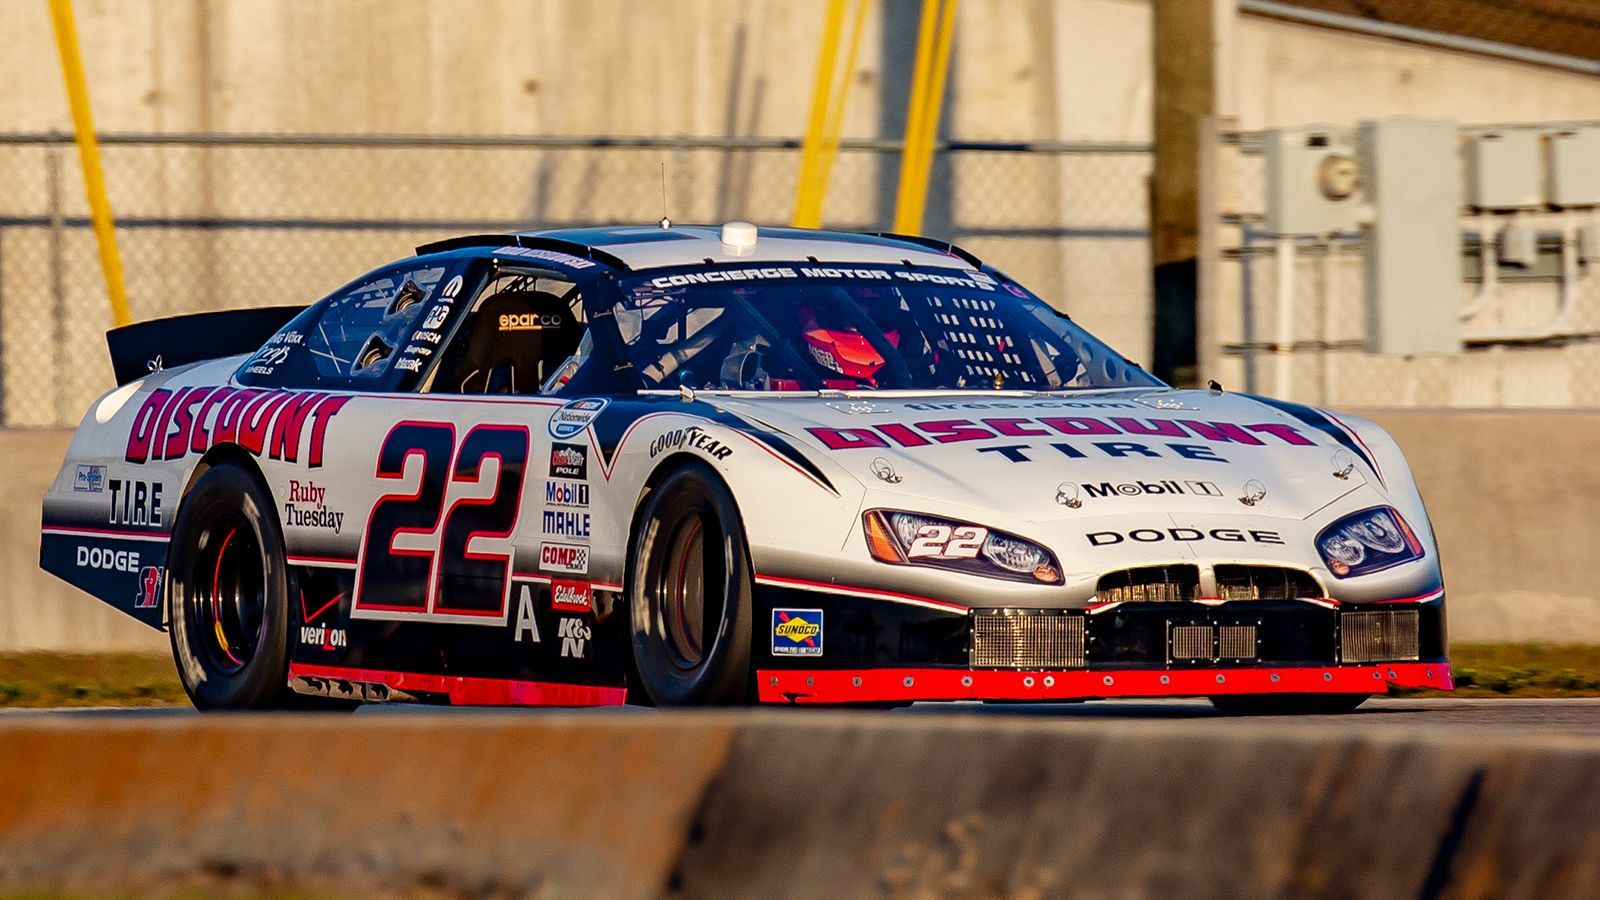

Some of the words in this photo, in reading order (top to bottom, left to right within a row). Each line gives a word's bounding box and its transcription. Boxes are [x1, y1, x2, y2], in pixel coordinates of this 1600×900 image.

[652, 267, 798, 288] CONCIERGE
[800, 267, 892, 280] MOTOR
[499, 313, 562, 331] sparco
[903, 402, 1138, 411] tires.com
[125, 386, 354, 469] DISCOUNT
[806, 417, 1318, 451] DISCOUNT
[648, 426, 733, 461] GOODYEAR
[975, 441, 1230, 463] TIRE
[556, 467, 579, 475] POLE
[289, 480, 326, 509] Ruby
[546, 481, 577, 503] Mobil
[1081, 481, 1185, 498] Mobil
[108, 479, 163, 528] TIRE
[285, 503, 344, 534] Tuesday
[354, 419, 530, 619] 22
[543, 510, 590, 537] MAHLE
[908, 525, 988, 559] 22
[1086, 528, 1286, 547] DODGE
[77, 546, 140, 573] DODGE
[542, 546, 577, 565] COMP
[554, 585, 588, 606] Edelbrock
[514, 584, 541, 642] A
[301, 626, 346, 650] verizon
[778, 625, 818, 635] SUNOCO
